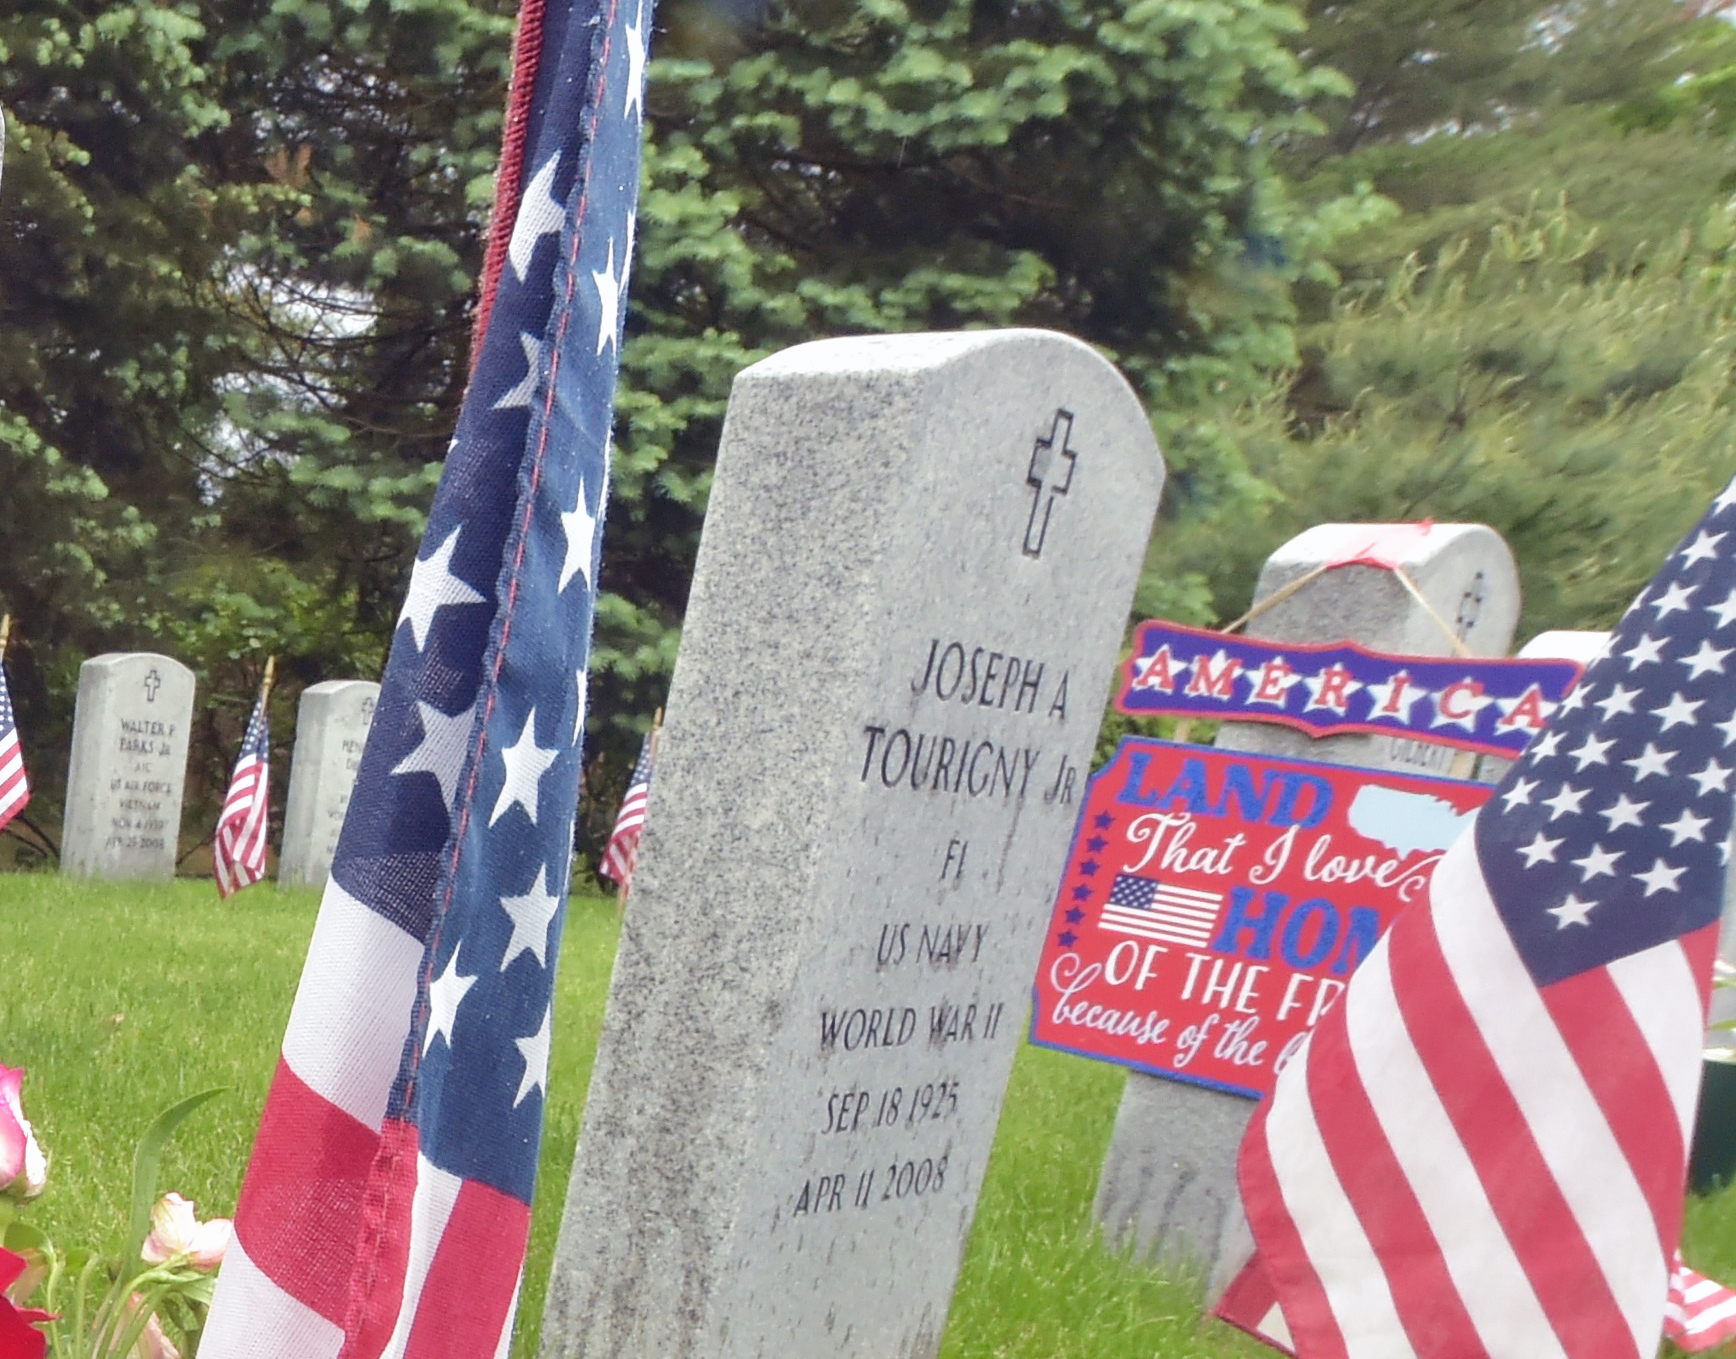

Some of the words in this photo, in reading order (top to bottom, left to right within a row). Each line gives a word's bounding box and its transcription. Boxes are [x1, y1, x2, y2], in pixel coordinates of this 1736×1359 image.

[910, 638, 1046, 714] JOSEPH
[1048, 669, 1070, 720] A
[1130, 647, 1548, 731] AMERICA
[120, 717, 165, 736] WALTER
[861, 725, 1041, 798] TOURIGNY
[1115, 751, 1335, 831] LAND
[1122, 810, 1247, 877] That
[1249, 823, 1302, 885] I
[1304, 834, 1439, 901] love
[876, 922, 911, 966] US
[916, 923, 990, 965] NAVY
[1213, 885, 1380, 976] HOM
[1050, 952, 1170, 1045] because
[1172, 1012, 1220, 1068] of
[1214, 1014, 1268, 1067] the
[1104, 939, 1169, 991] OF
[1180, 952, 1271, 1015] THE
[820, 1006, 917, 1051] WORLD
[928, 1003, 978, 1044] WAR
[982, 1002, 1005, 1040] II
[820, 1091, 870, 1136] SEP
[876, 1086, 903, 1127] 18
[908, 1081, 961, 1123] 1925
[792, 1172, 846, 1218] APR
[880, 1154, 949, 1202] 2008
